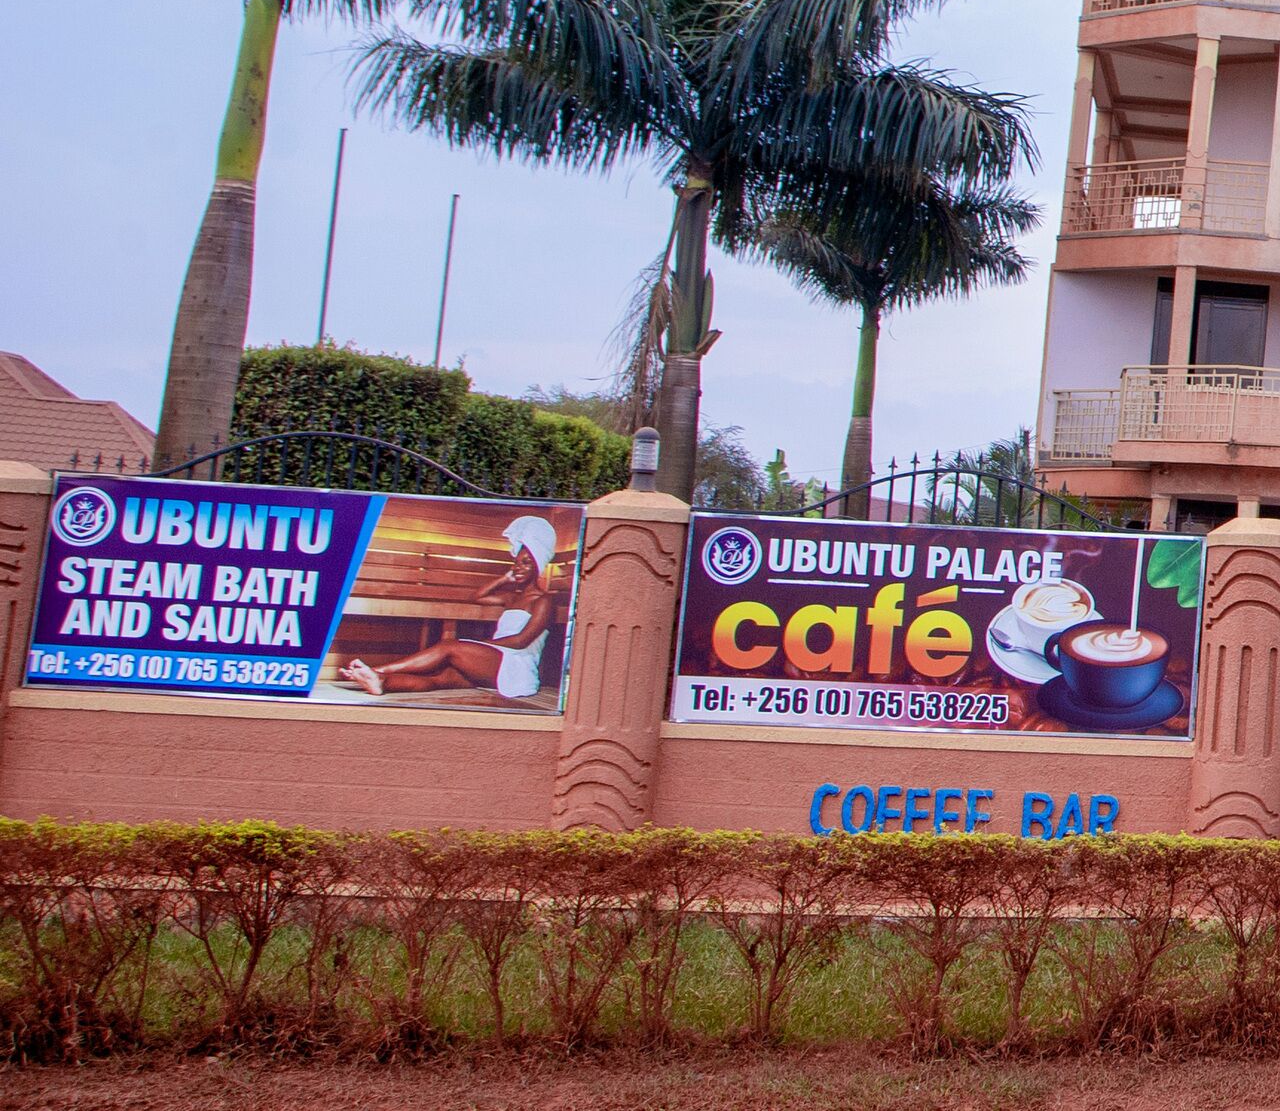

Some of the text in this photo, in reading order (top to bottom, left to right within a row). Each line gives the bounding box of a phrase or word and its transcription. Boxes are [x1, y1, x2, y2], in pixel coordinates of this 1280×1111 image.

[121, 495, 335, 555] UBUNTU
[57, 555, 319, 608] STEAM BATH
[767, 537, 1064, 585] UBUNTU PALACE
[59, 599, 302, 648] AND SAUNA
[712, 583, 973, 678] café
[28, 650, 310, 687] Tel: +256 (0) 765 538225
[690, 684, 1009, 724] Tel: +256 (0) 765 538225
[810, 782, 1120, 840] COFFEE BAR
